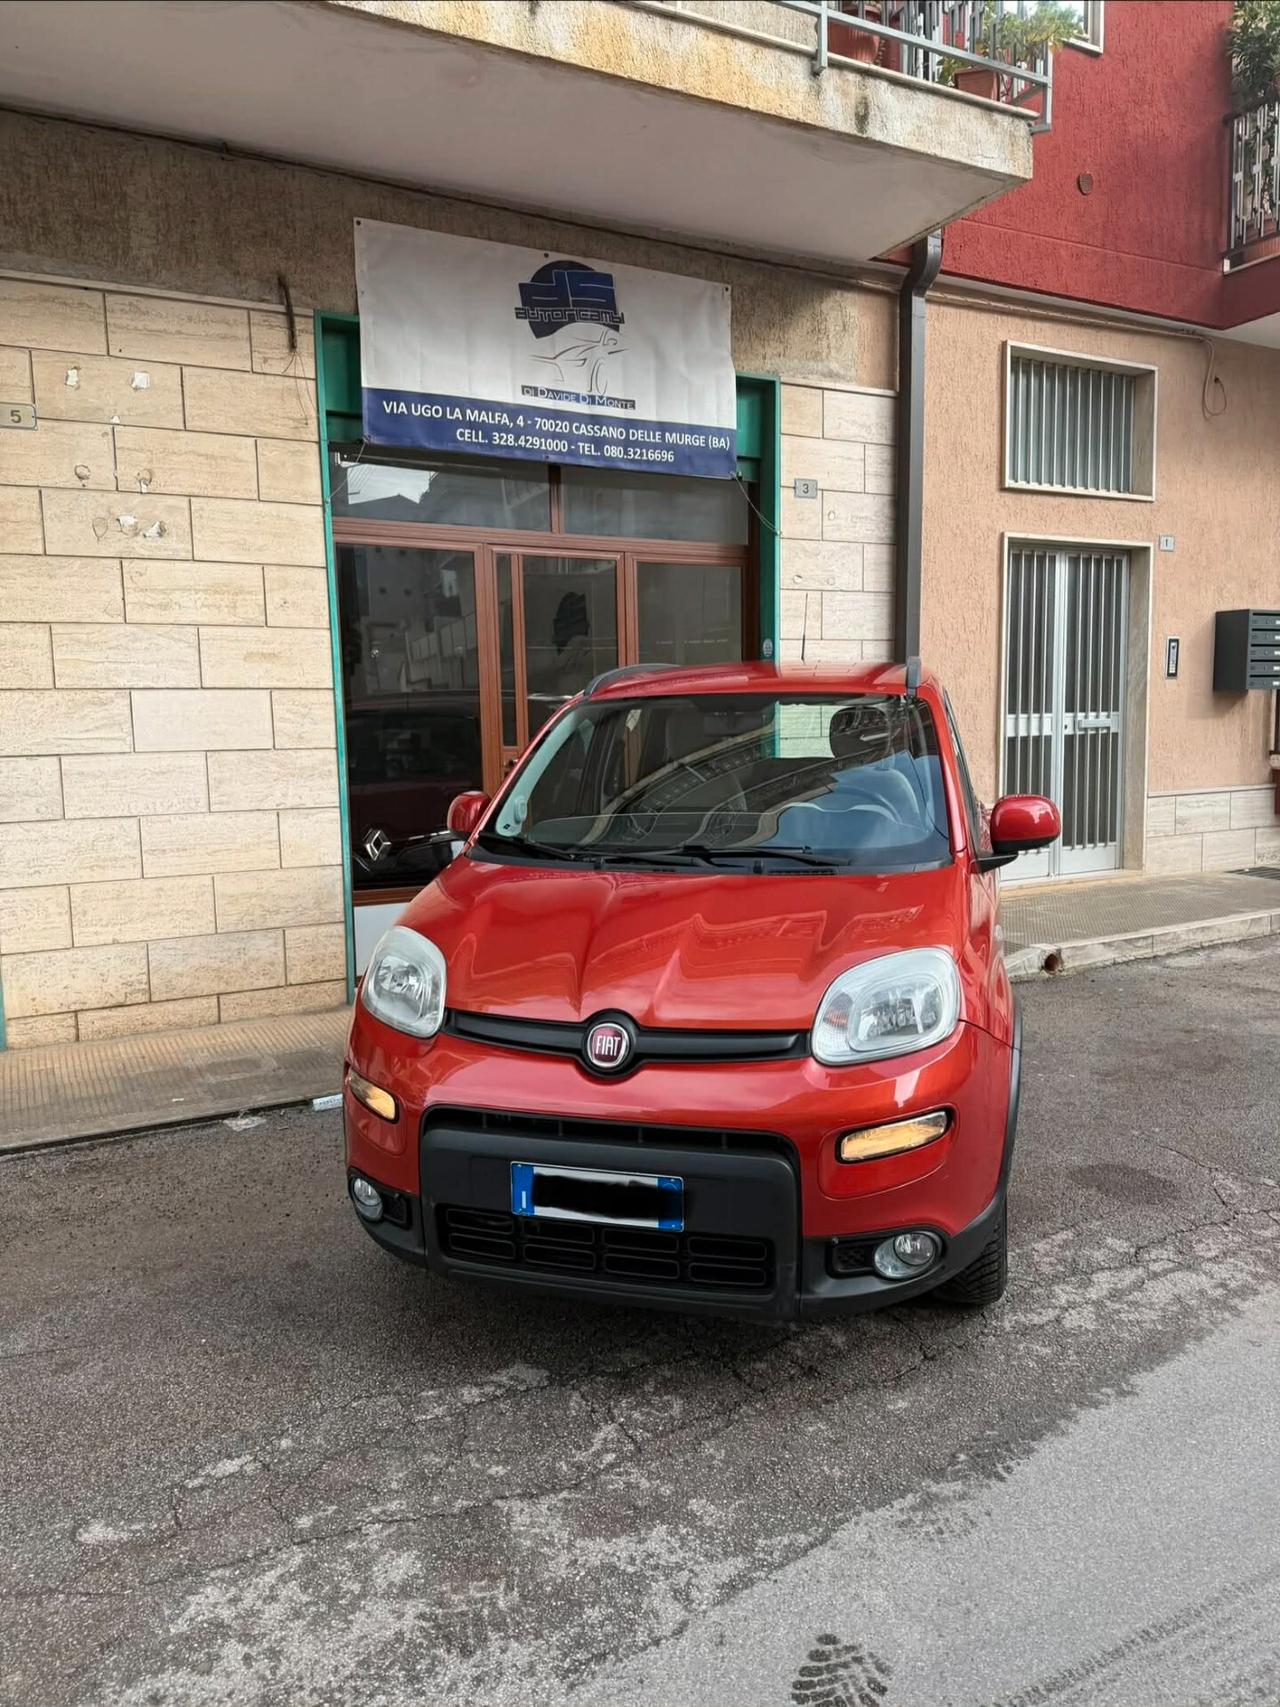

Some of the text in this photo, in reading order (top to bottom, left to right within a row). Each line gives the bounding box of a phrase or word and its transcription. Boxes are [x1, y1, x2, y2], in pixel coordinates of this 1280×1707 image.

[10, 409, 22, 424] 5
[383, 401, 407, 414] VIA
[411, 403, 442, 418] UGO
[446, 408, 462, 420] LA
[466, 409, 514, 427] MALFA,
[516, 415, 524, 426] 4
[534, 417, 569, 433] 70020
[573, 422, 626, 439] CASSANO
[629, 429, 662, 443] DELLE
[665, 432, 706, 447] MURGE
[708, 435, 730, 450] (BA)
[456, 428, 488, 443] CELL.
[492, 431, 567, 452] 328.4291000
[577, 442, 600, 455] TEL.
[604, 445, 674, 462] 080.3216696
[802, 483, 810, 494] 3
[595, 1035, 621, 1056] FIAT
